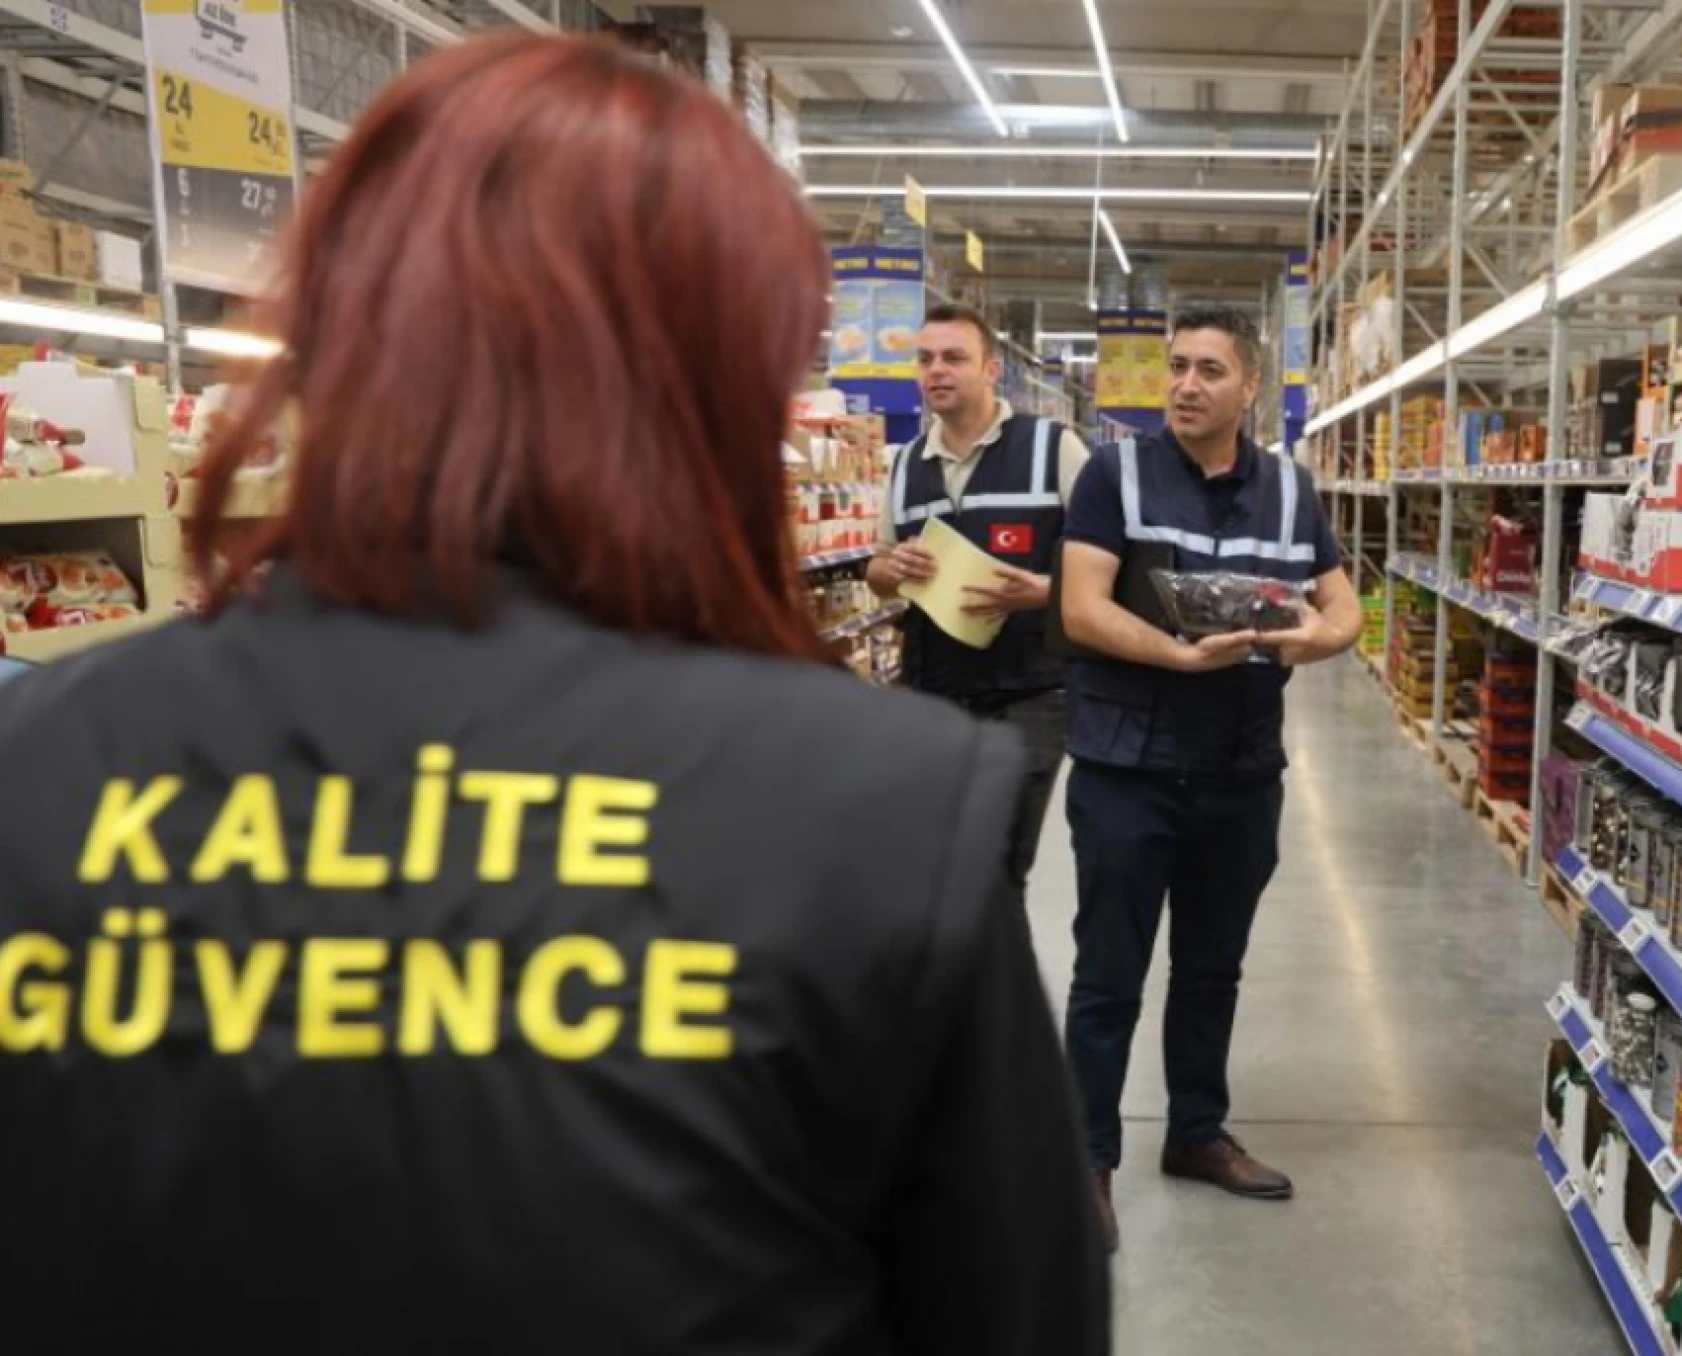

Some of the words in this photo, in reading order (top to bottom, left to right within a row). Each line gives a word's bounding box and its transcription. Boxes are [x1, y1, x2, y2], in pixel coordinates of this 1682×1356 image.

[161, 75, 193, 119] 24
[77, 743, 659, 888] KALİTE
[0, 907, 738, 1060] GÜVENCE
